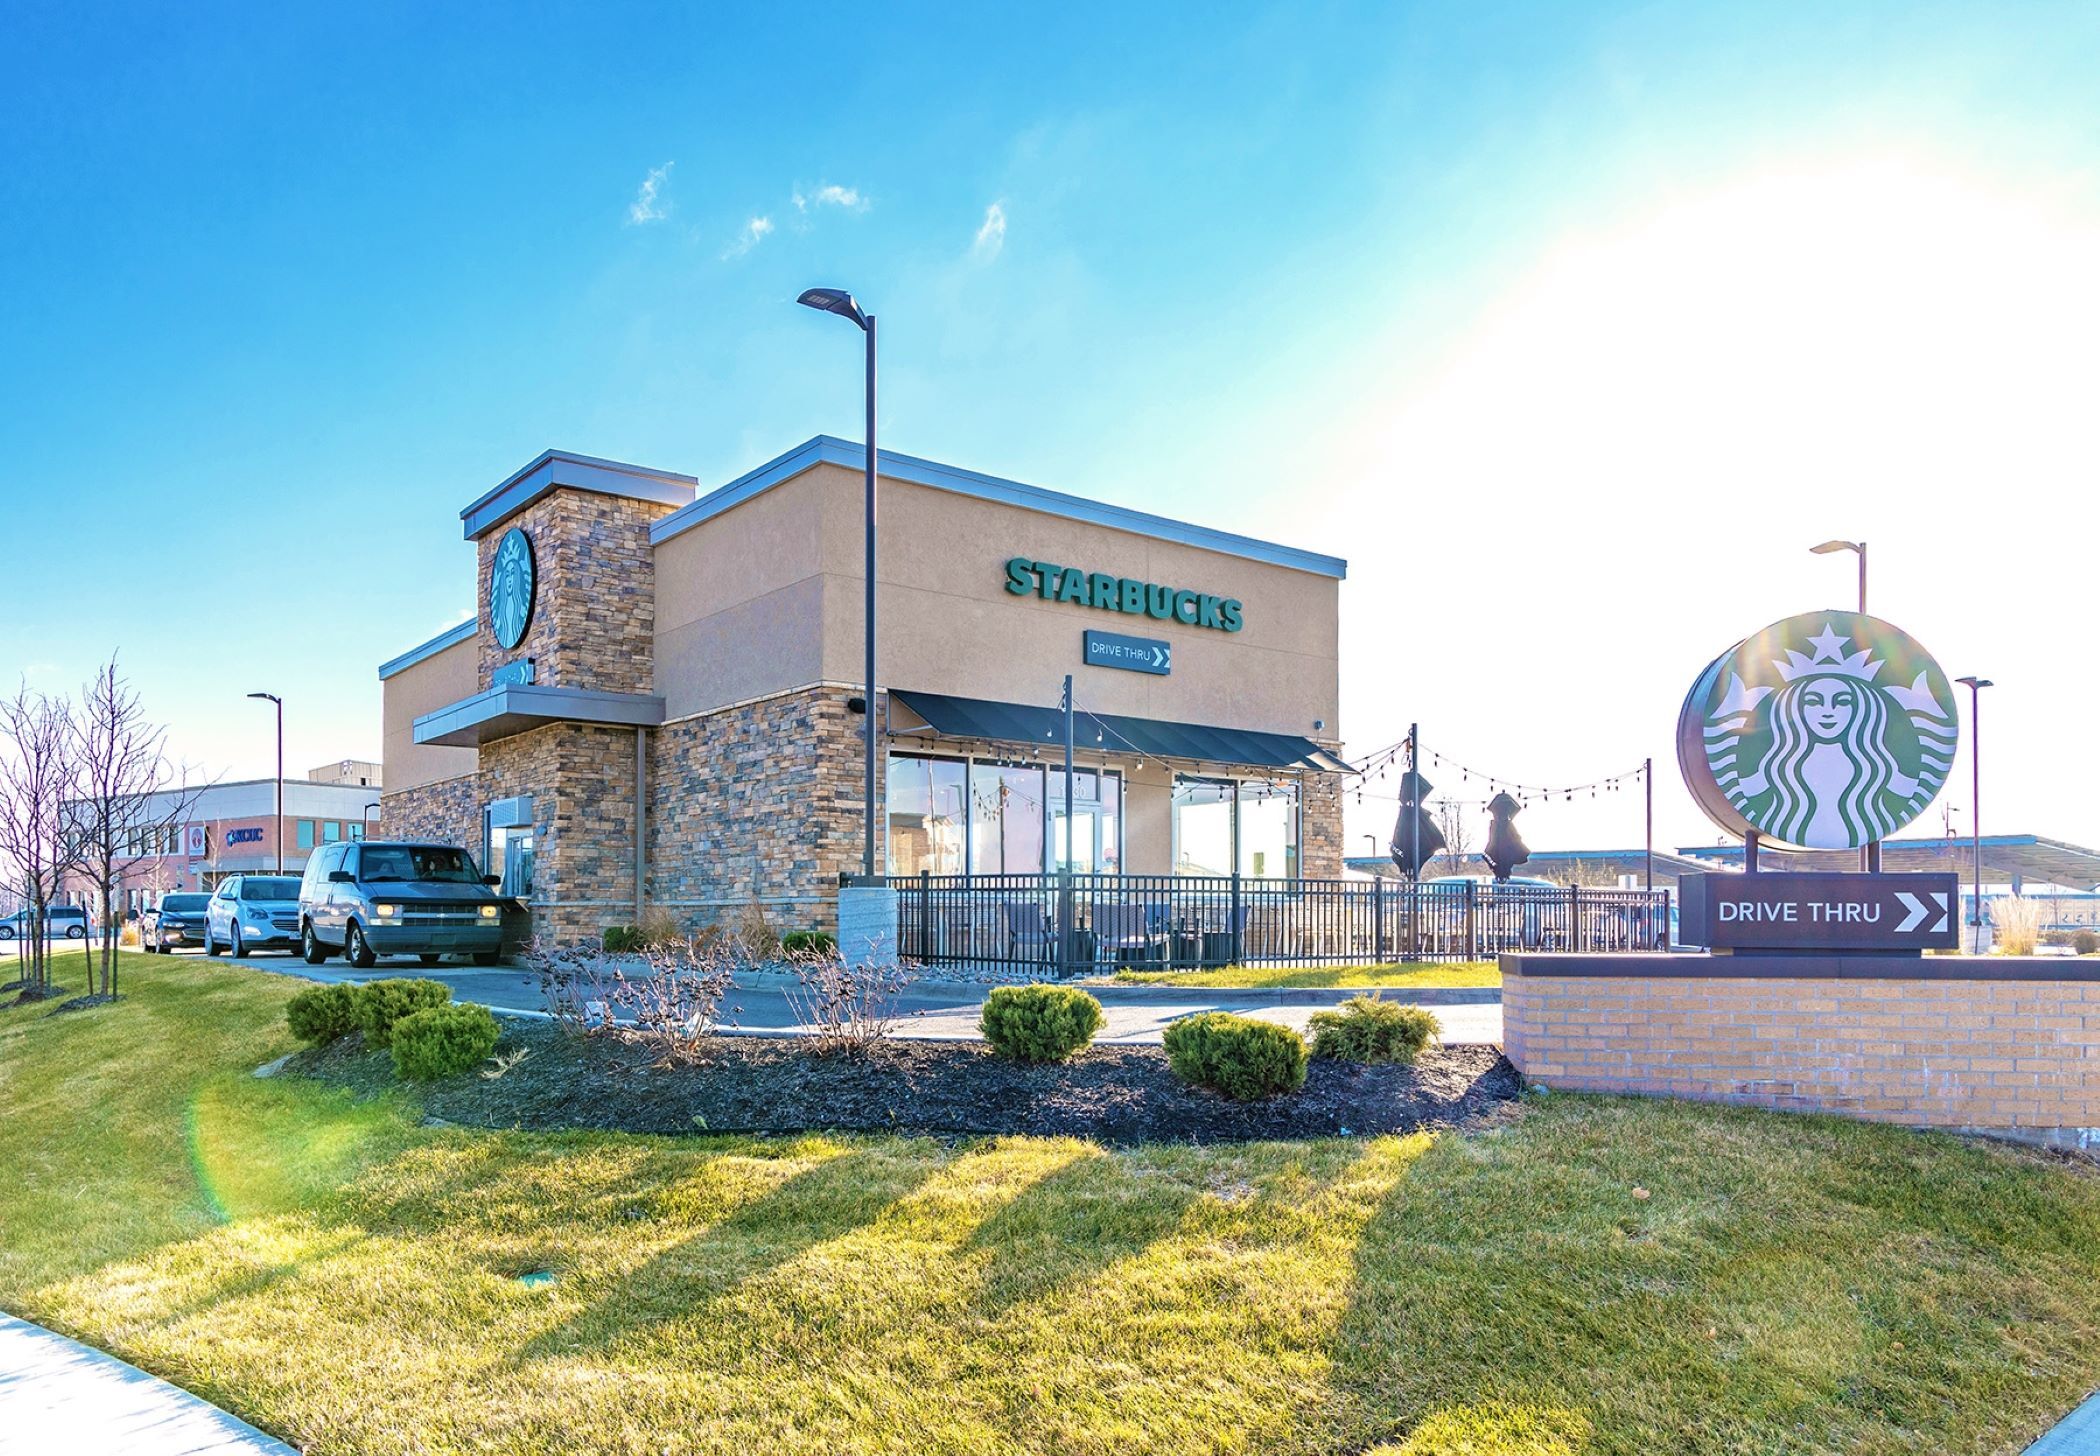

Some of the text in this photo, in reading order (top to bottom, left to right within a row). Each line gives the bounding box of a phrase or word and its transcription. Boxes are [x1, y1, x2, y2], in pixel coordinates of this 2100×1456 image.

[1005, 557, 1243, 632] STARBUCKS
[1091, 642, 1151, 661] DRIVE THRU
[1719, 902, 1880, 922] DRIVE THRU
